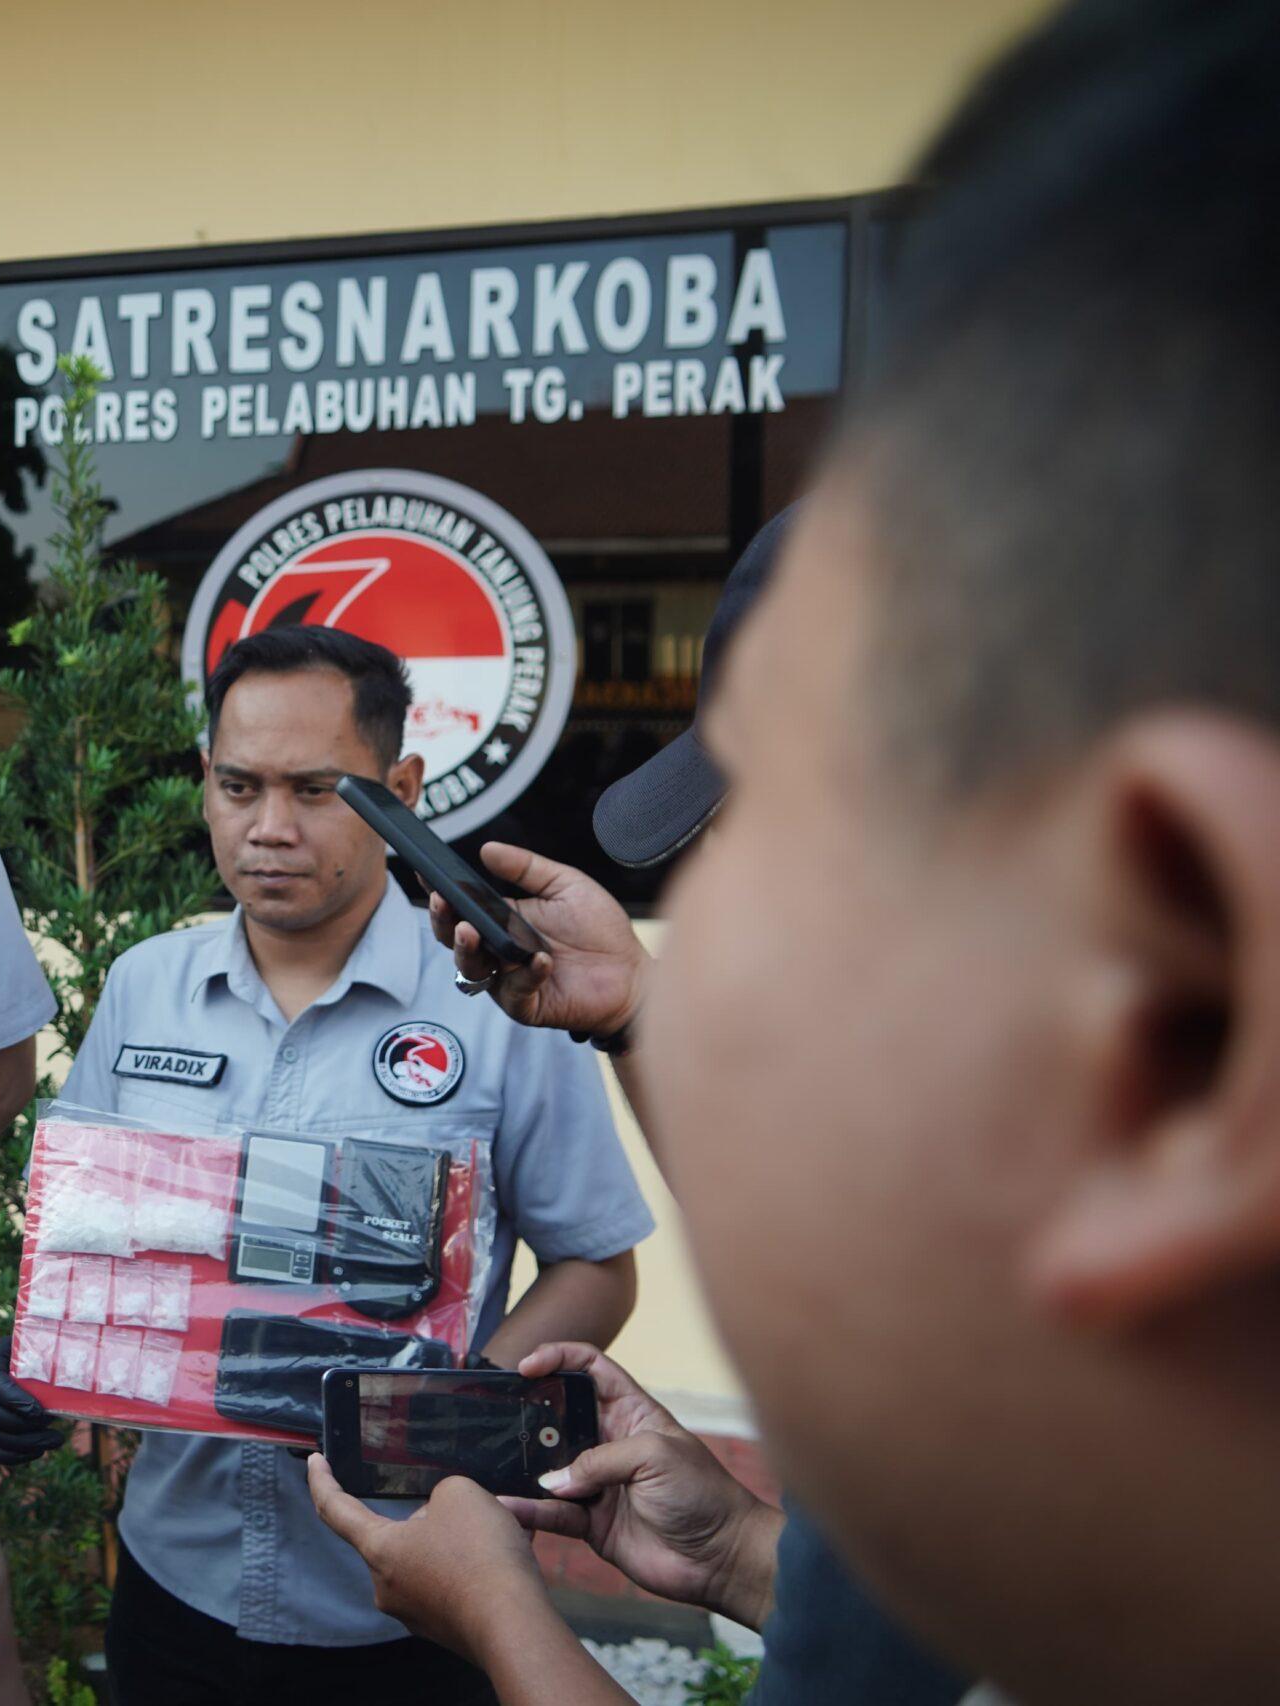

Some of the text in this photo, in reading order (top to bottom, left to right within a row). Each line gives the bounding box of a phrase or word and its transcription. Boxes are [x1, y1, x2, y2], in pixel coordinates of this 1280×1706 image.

[15, 247, 787, 386] SATRESNARKOBA
[201, 370, 477, 439] PELABUHAN
[502, 366, 584, 424] TG.
[611, 353, 787, 420] PERAK
[237, 512, 326, 590] POLRES
[323, 495, 476, 550] PELABUHAN
[134, 1053, 207, 1077] VIRADIX
[363, 1214, 411, 1230] POCKET
[382, 1230, 420, 1244] SCALE
